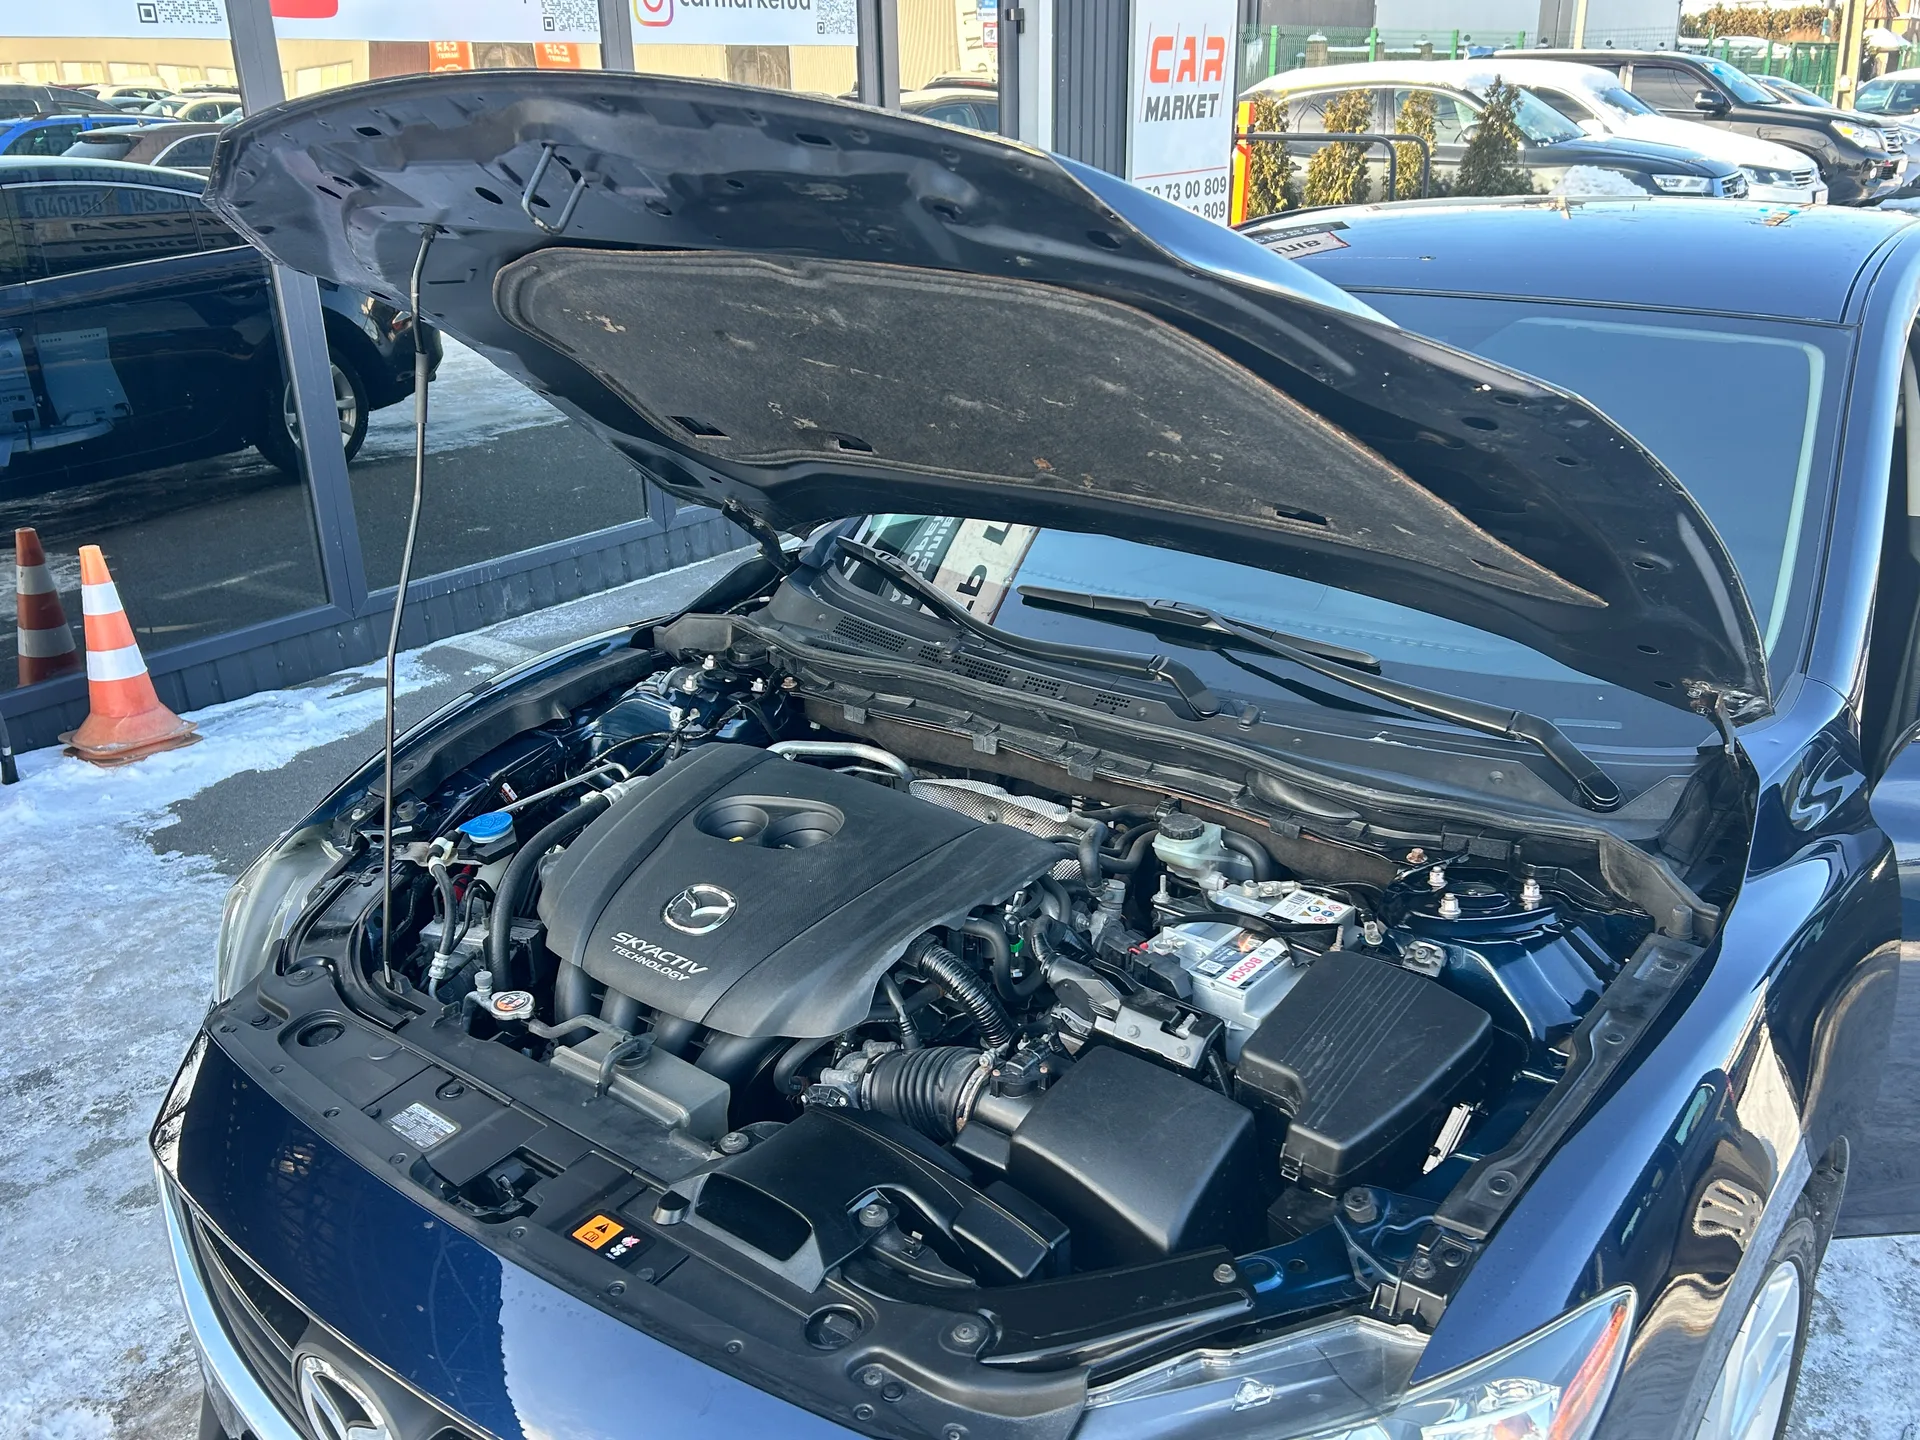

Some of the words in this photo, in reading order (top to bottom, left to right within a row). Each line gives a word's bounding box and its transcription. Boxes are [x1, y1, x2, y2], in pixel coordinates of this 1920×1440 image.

[1150, 36, 1226, 83] CAR
[1144, 93, 1219, 122] MARKET
[1165, 182, 1181, 201] 73
[1185, 179, 1201, 199] 00
[1204, 175, 1227, 196] 809
[610, 932, 709, 974] SKYACTIV
[611, 944, 691, 981] TECHNOLOGY
[1226, 957, 1263, 982] BOSCH
